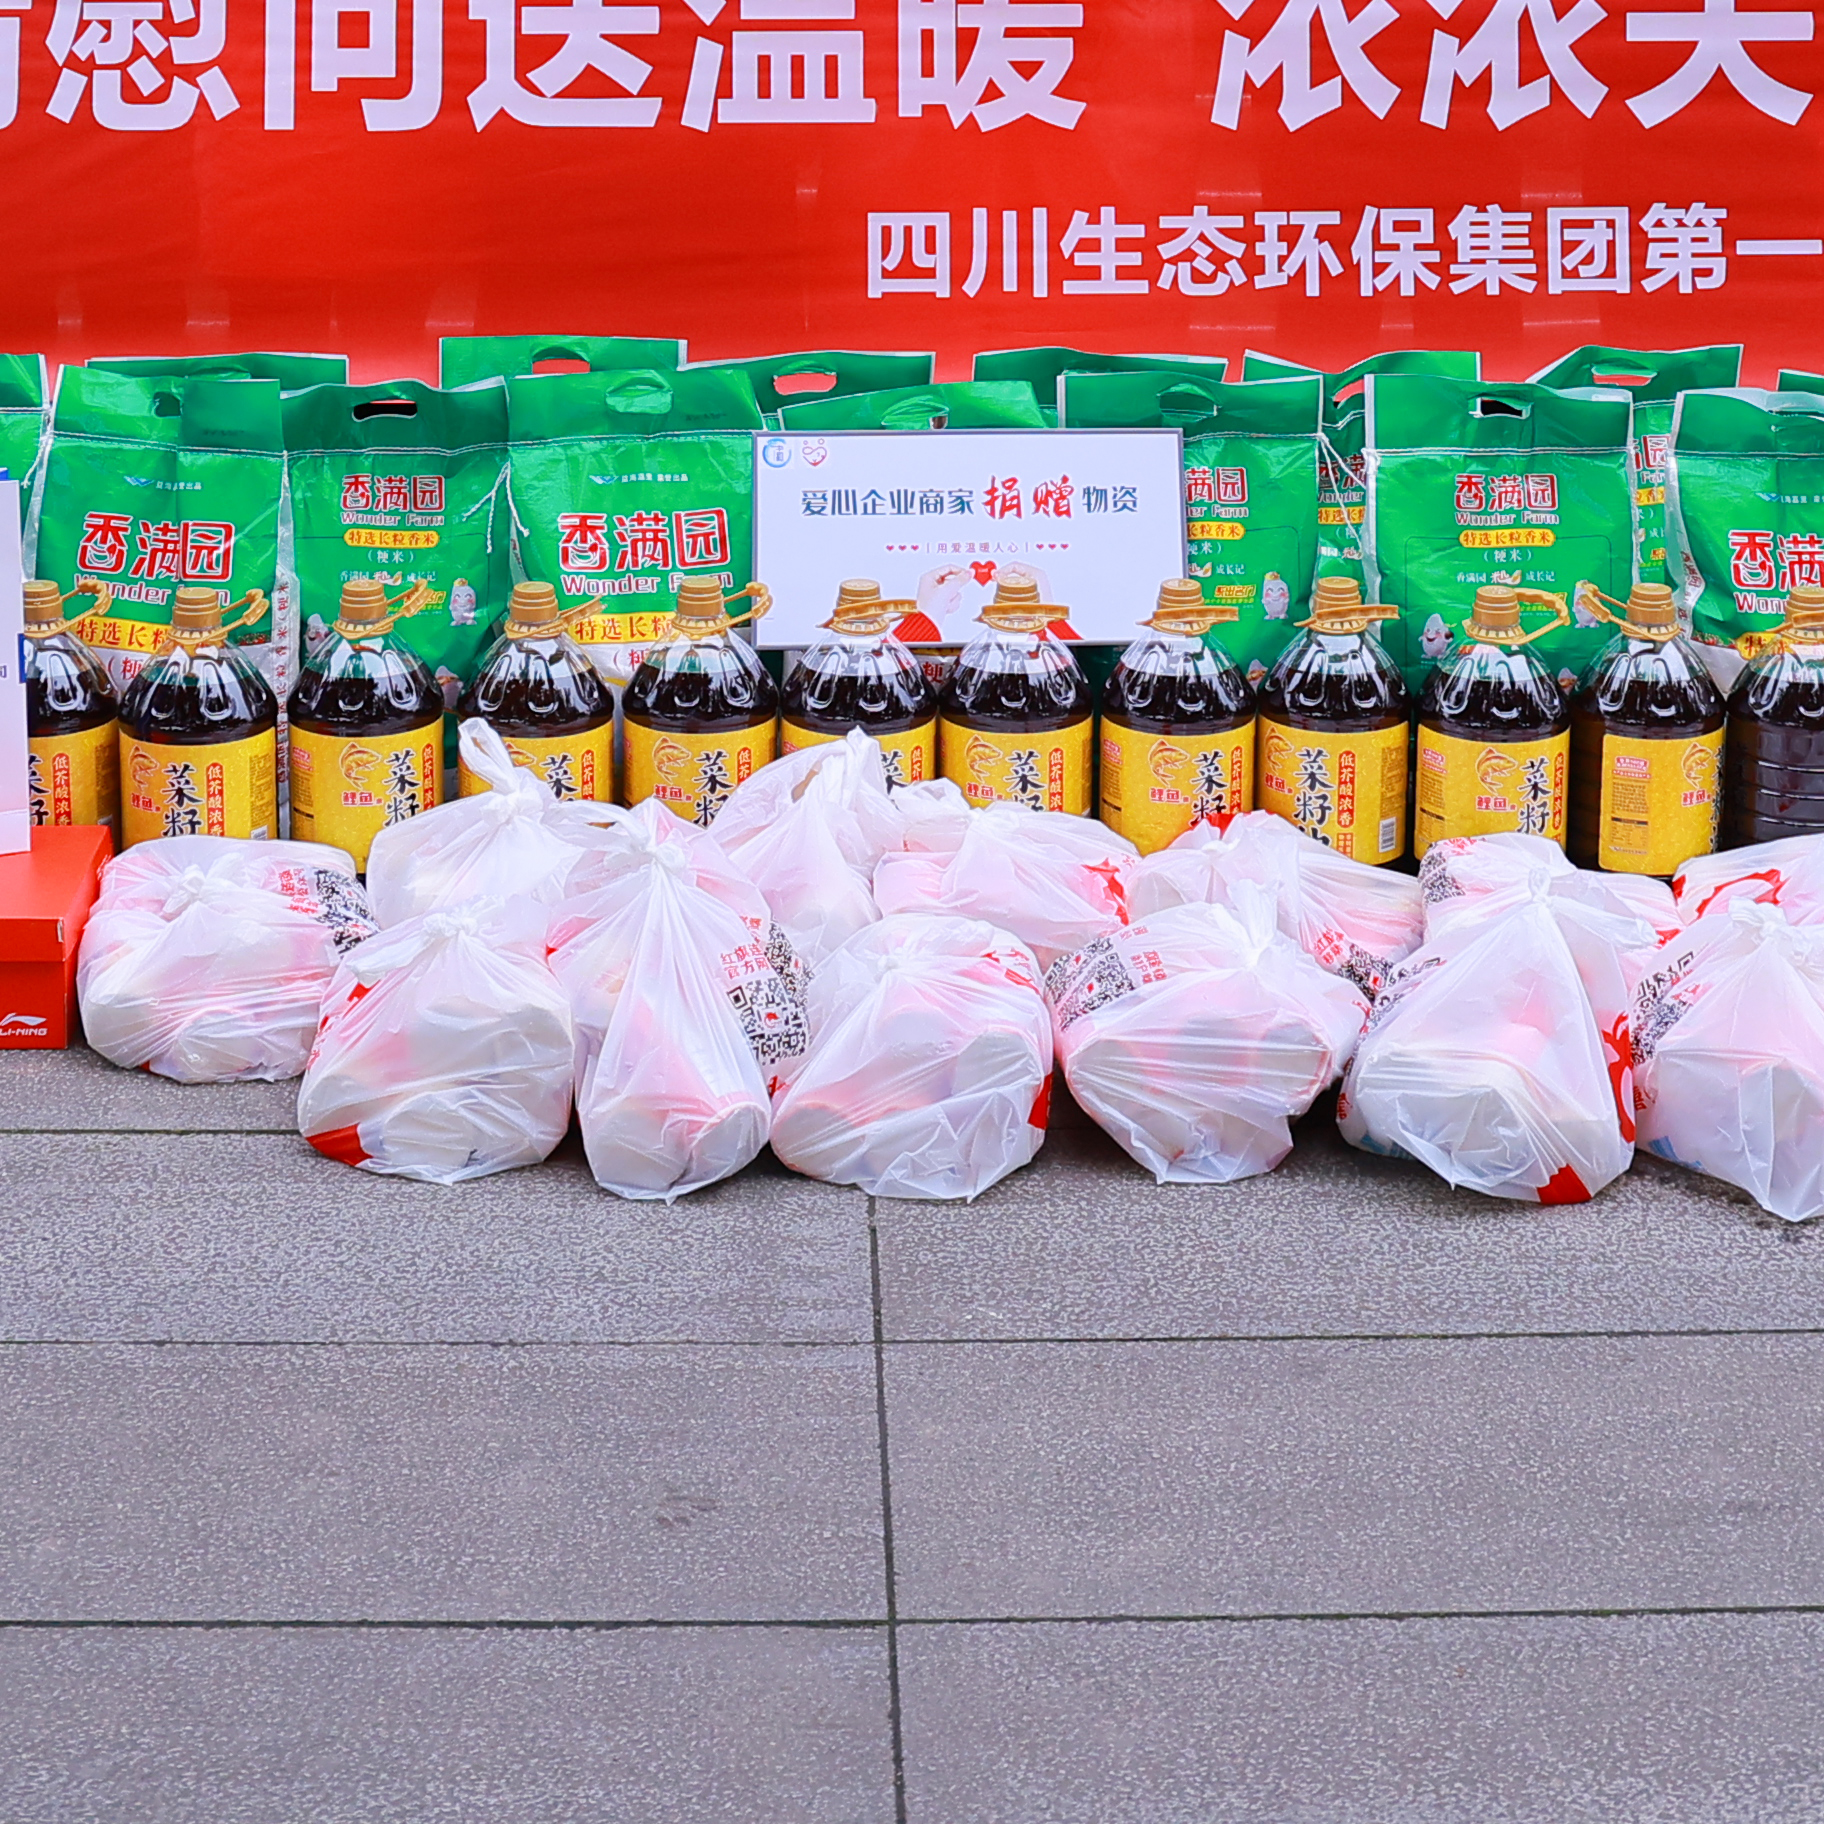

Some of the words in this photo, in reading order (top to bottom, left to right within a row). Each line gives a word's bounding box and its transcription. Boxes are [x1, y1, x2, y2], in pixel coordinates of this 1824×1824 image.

[340, 473, 446, 512] 香满园
[1454, 473, 1559, 512] 香满园
[340, 512, 401, 527] Wonder
[405, 512, 445, 527] Farm
[1455, 511, 1517, 527] Wonder
[1520, 511, 1560, 527] Farm
[76, 511, 236, 583] 香满园
[347, 532, 436, 547] 特选长粒香米
[558, 507, 731, 573] 香满园
[1462, 530, 1552, 546] 特选长粒香米
[561, 573, 661, 597] Wonder
[720, 943, 765, 965] 红旗连
[723, 956, 772, 980] 官方网
